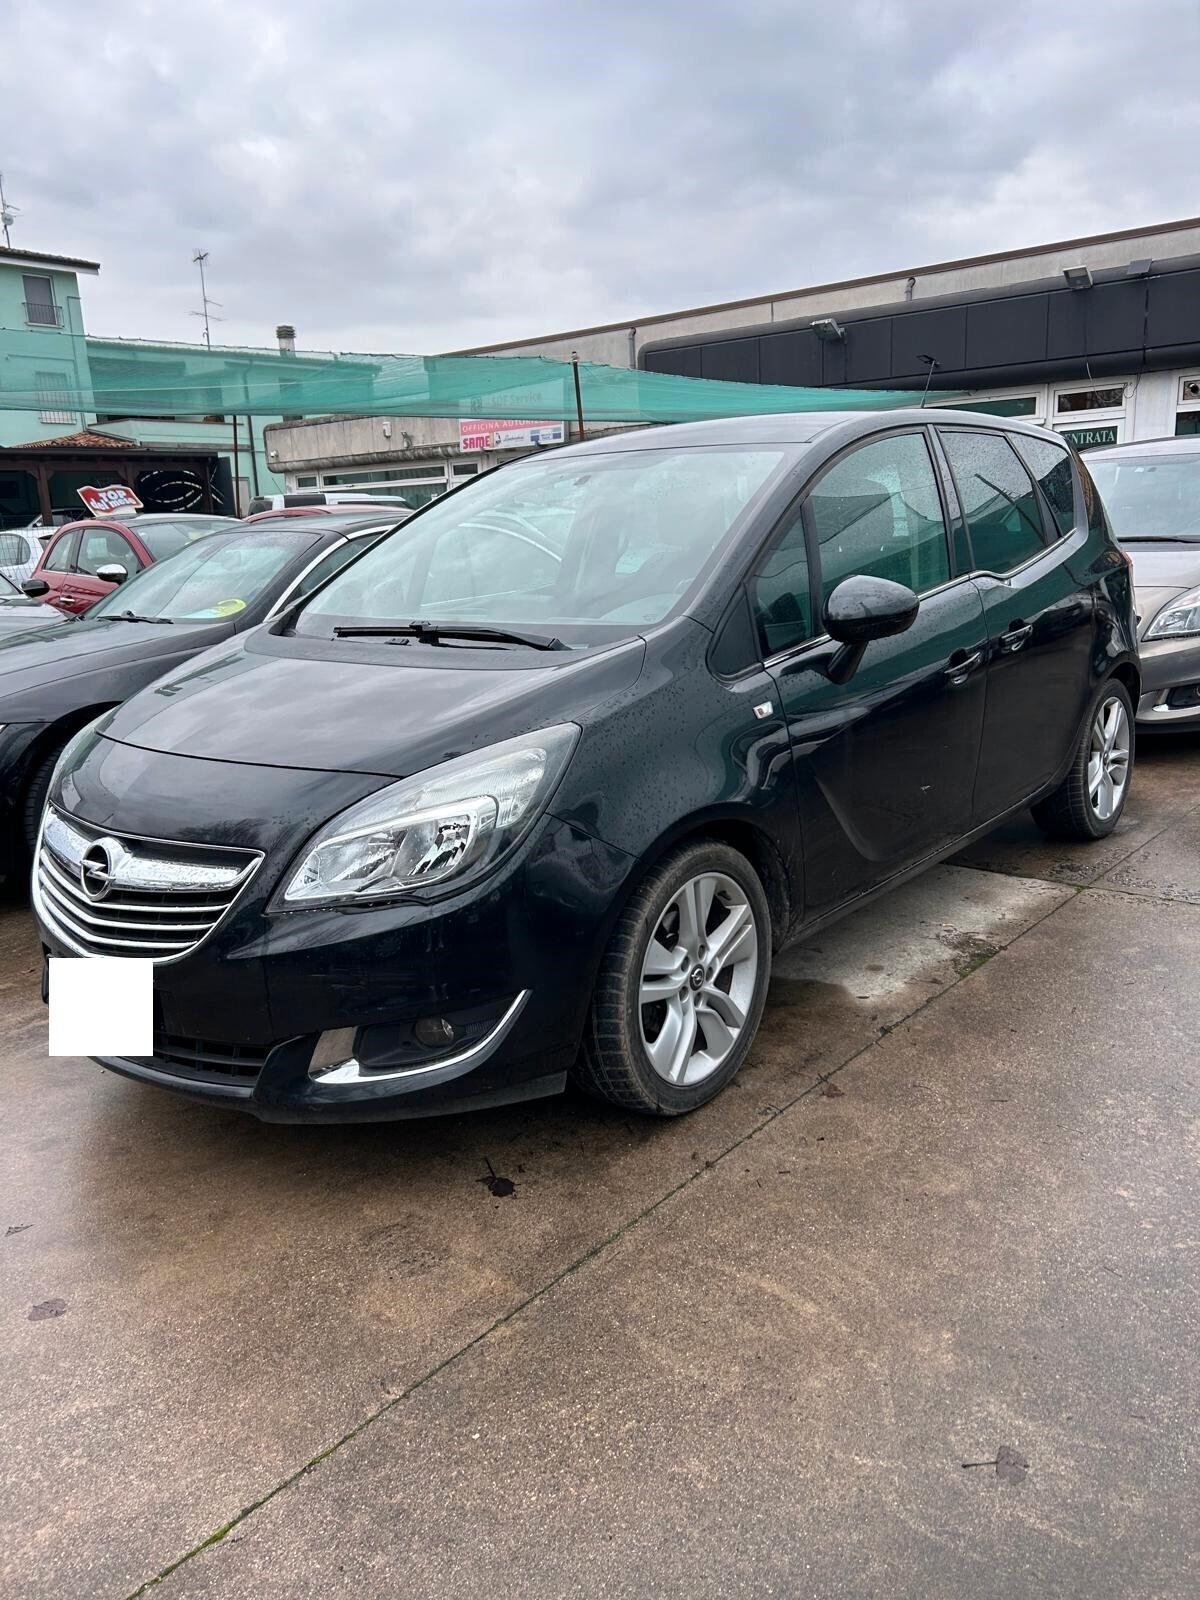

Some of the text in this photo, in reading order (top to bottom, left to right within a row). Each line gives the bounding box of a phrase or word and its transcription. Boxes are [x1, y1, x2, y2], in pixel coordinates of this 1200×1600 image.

[462, 421, 500, 433] OFFICINA
[462, 436, 490, 449] SAME
[98, 490, 126, 503] TOP
[90, 497, 110, 510] del
